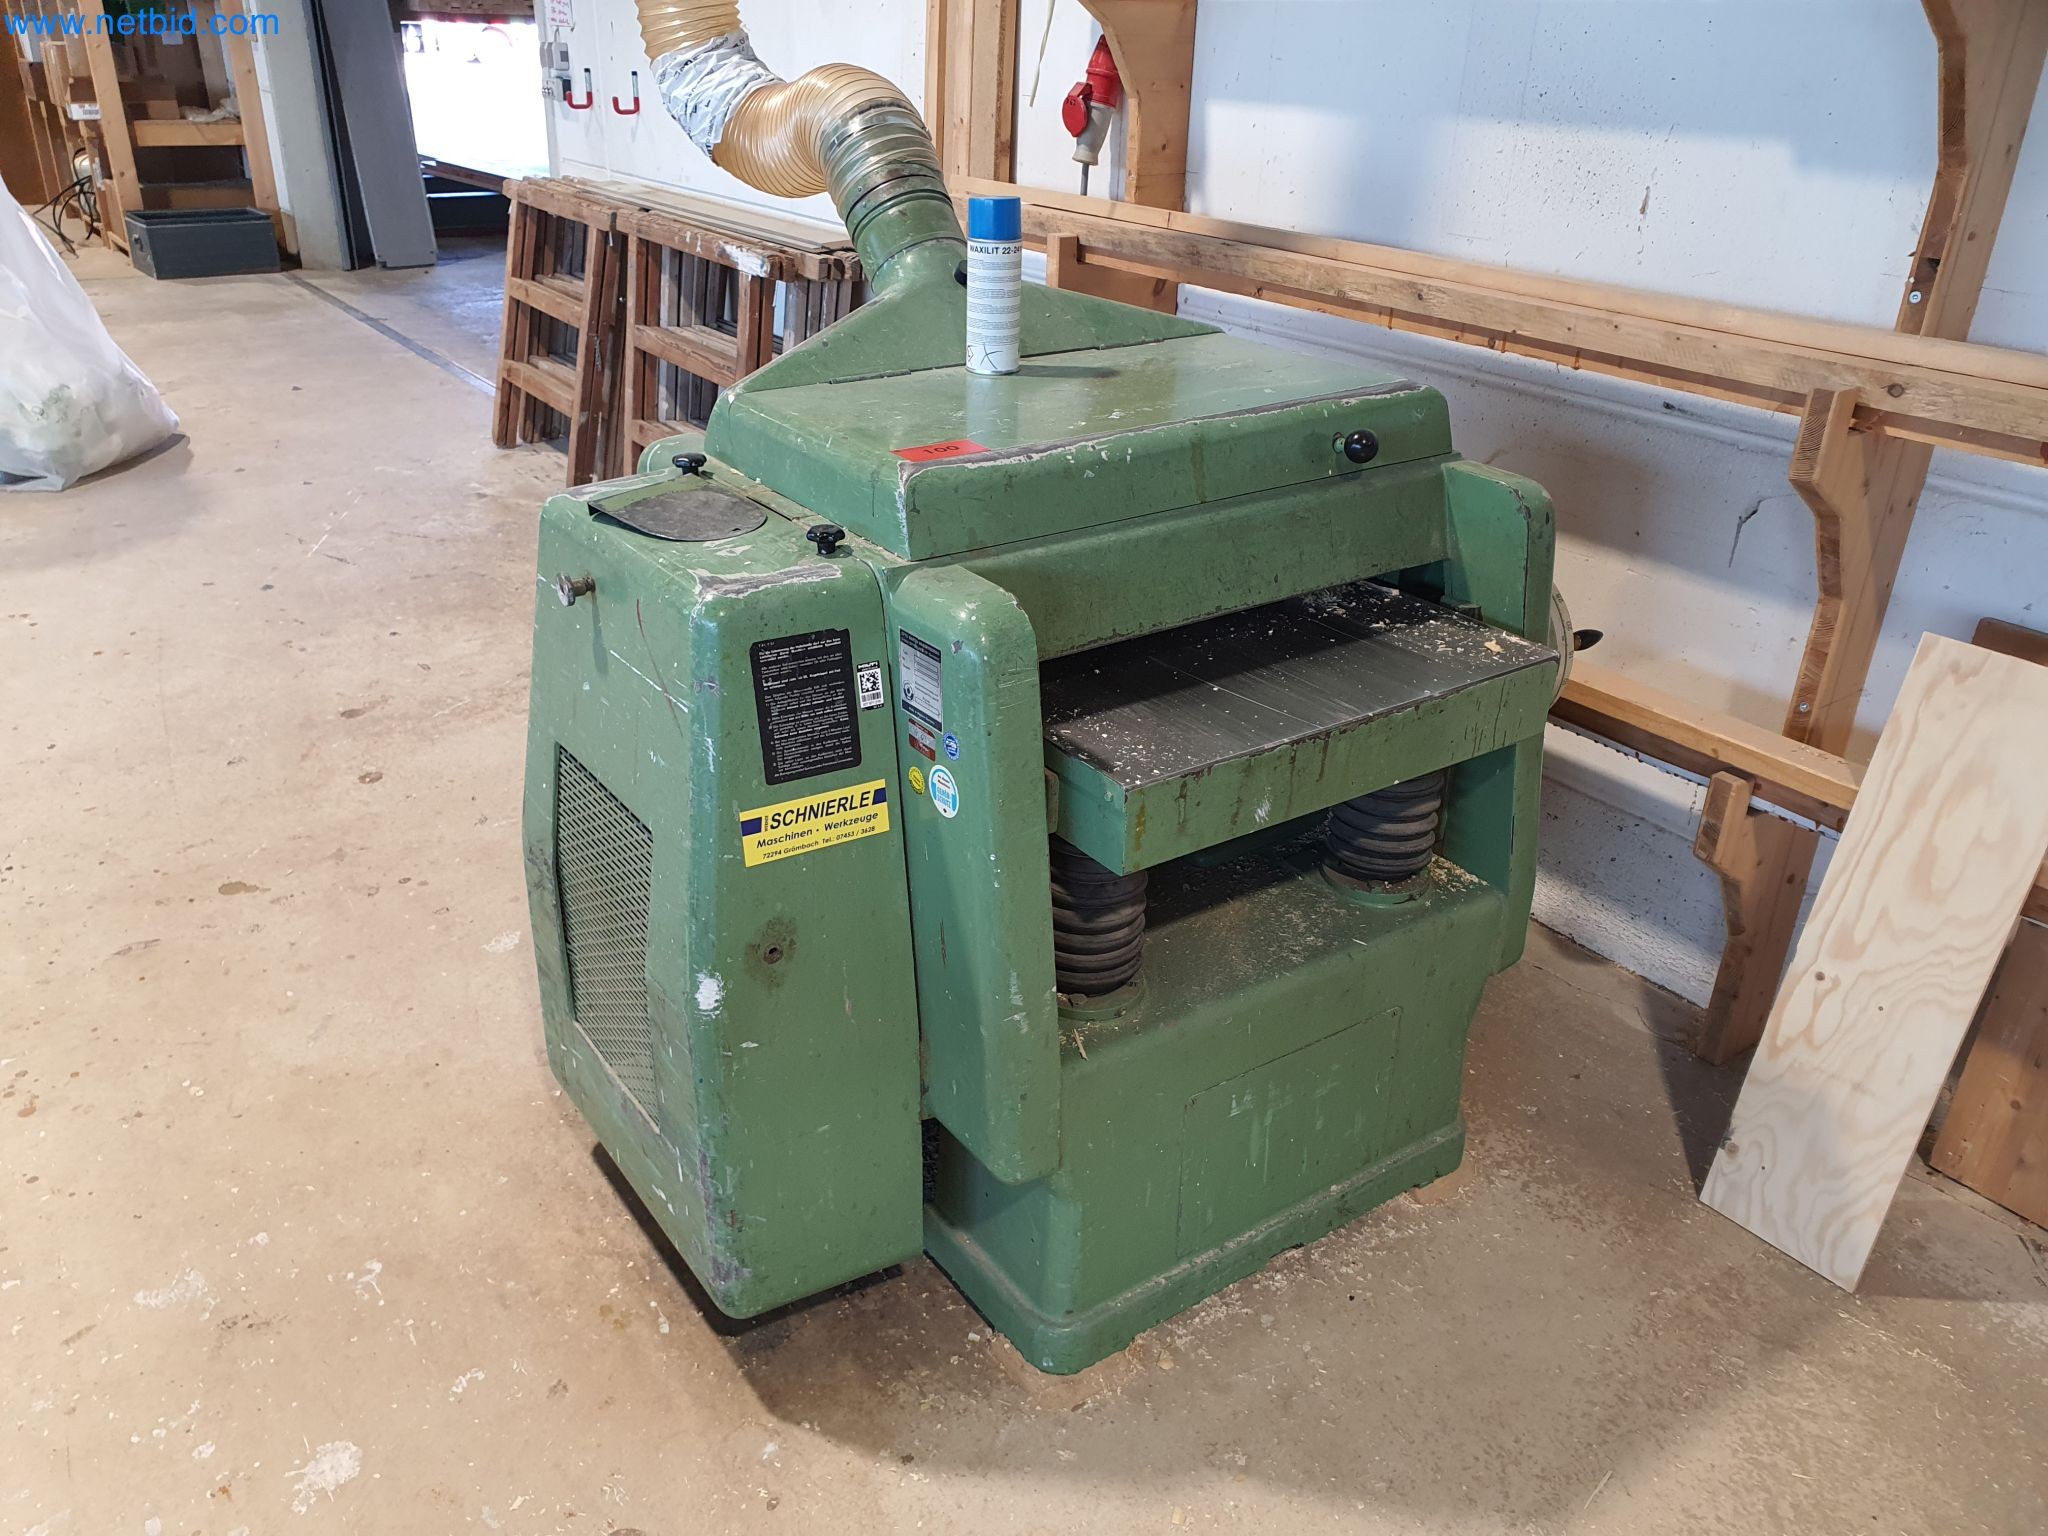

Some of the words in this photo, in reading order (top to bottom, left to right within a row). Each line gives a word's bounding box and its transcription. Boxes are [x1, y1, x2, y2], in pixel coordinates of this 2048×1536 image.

[923, 445, 960, 455] 100
[770, 790, 871, 830] SCHNIERLE
[756, 828, 813, 849] Maschinen
[824, 812, 879, 832] Werkzeuge
[762, 849, 782, 860] 72294
[783, 840, 819, 854] Grömbach
[835, 831, 855, 841] 07453
[860, 825, 876, 835] 3628
